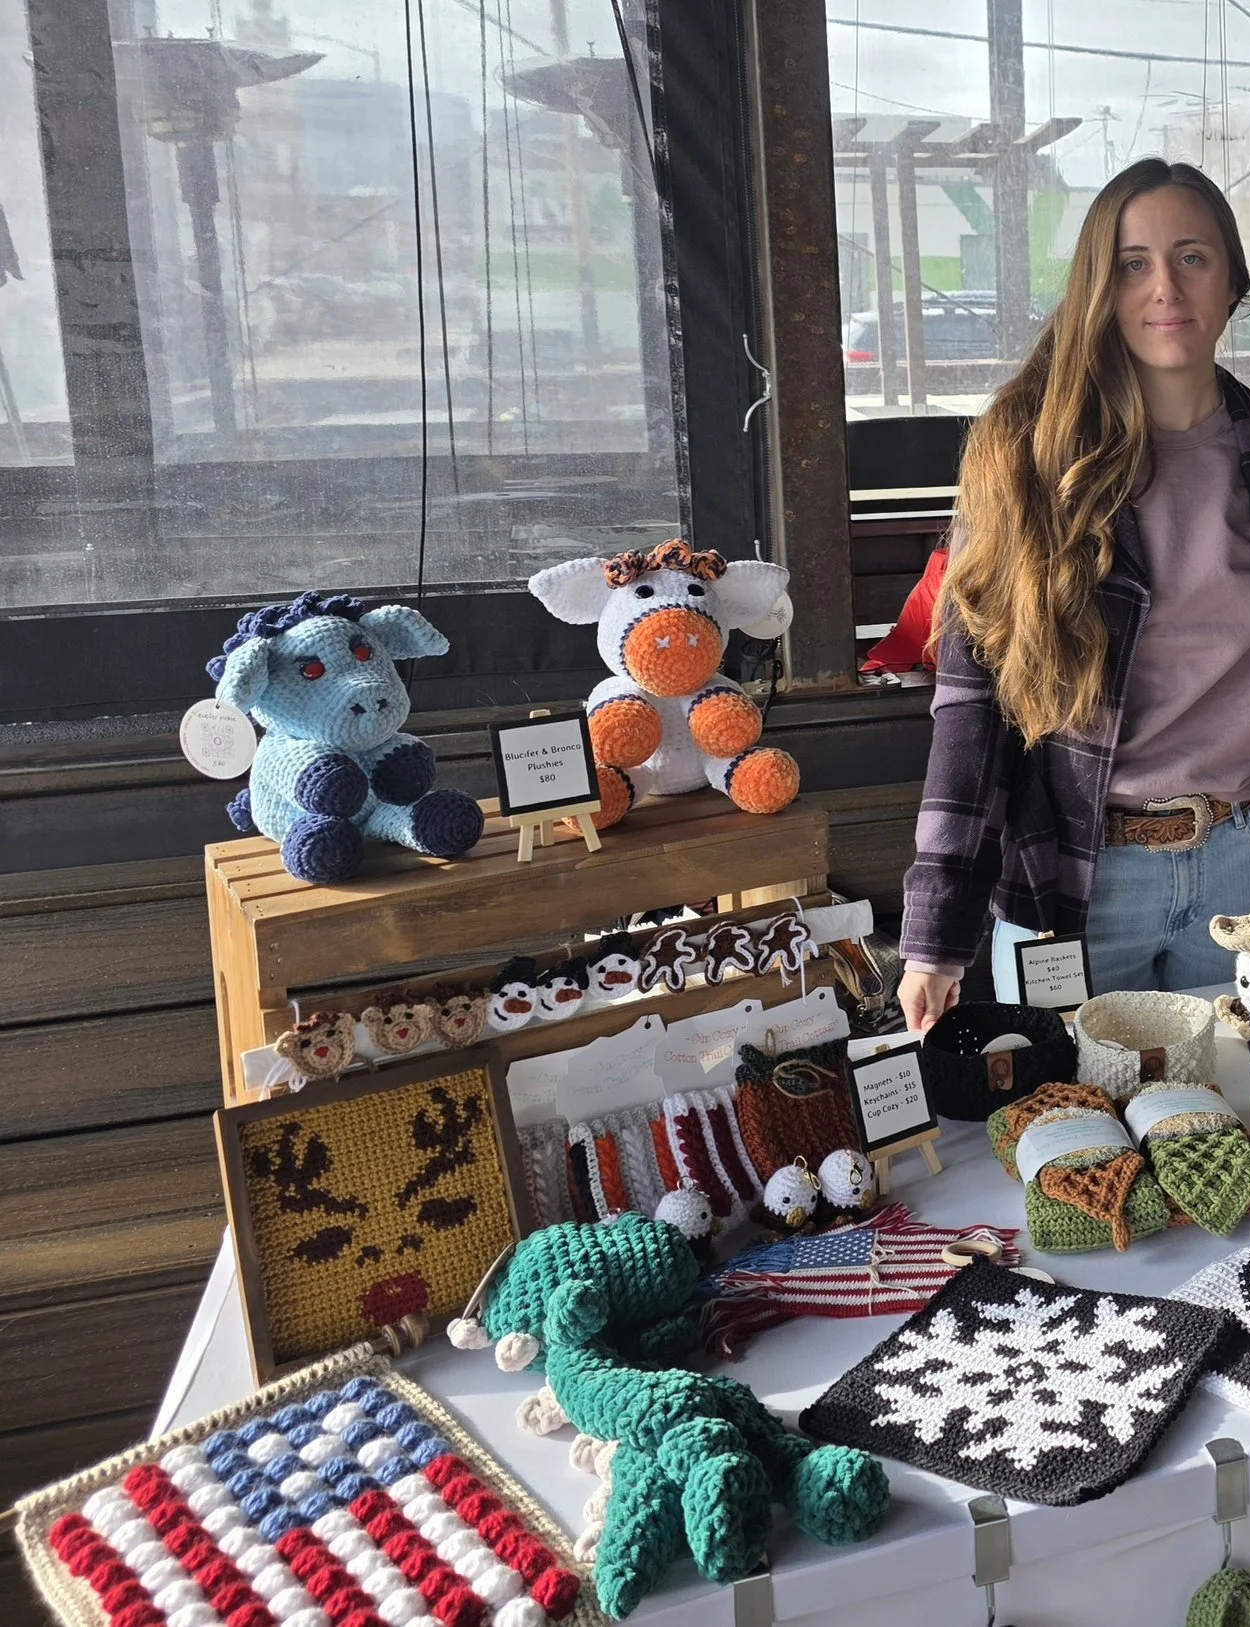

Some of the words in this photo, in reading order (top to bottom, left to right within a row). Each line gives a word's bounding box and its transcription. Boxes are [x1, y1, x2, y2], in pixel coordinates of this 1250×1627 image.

[504, 750, 538, 760] Blucifer
[550, 744, 580, 754] Bronco
[528, 760, 564, 771] Plushies
[540, 774, 556, 783] $80
[1050, 954, 1076, 962] Baskets
[1026, 977, 1050, 985] Kitchen
[692, 1033, 711, 1044] Cup
[712, 1028, 739, 1041] Cozy
[664, 1051, 697, 1064] Cotton
[699, 1049, 723, 1062] Trail
[864, 1078, 893, 1092] Magnets
[904, 1081, 916, 1091] $15
[867, 1109, 881, 1118] Cup
[882, 1103, 899, 1113] Cozy
[905, 1094, 918, 1105] $20
